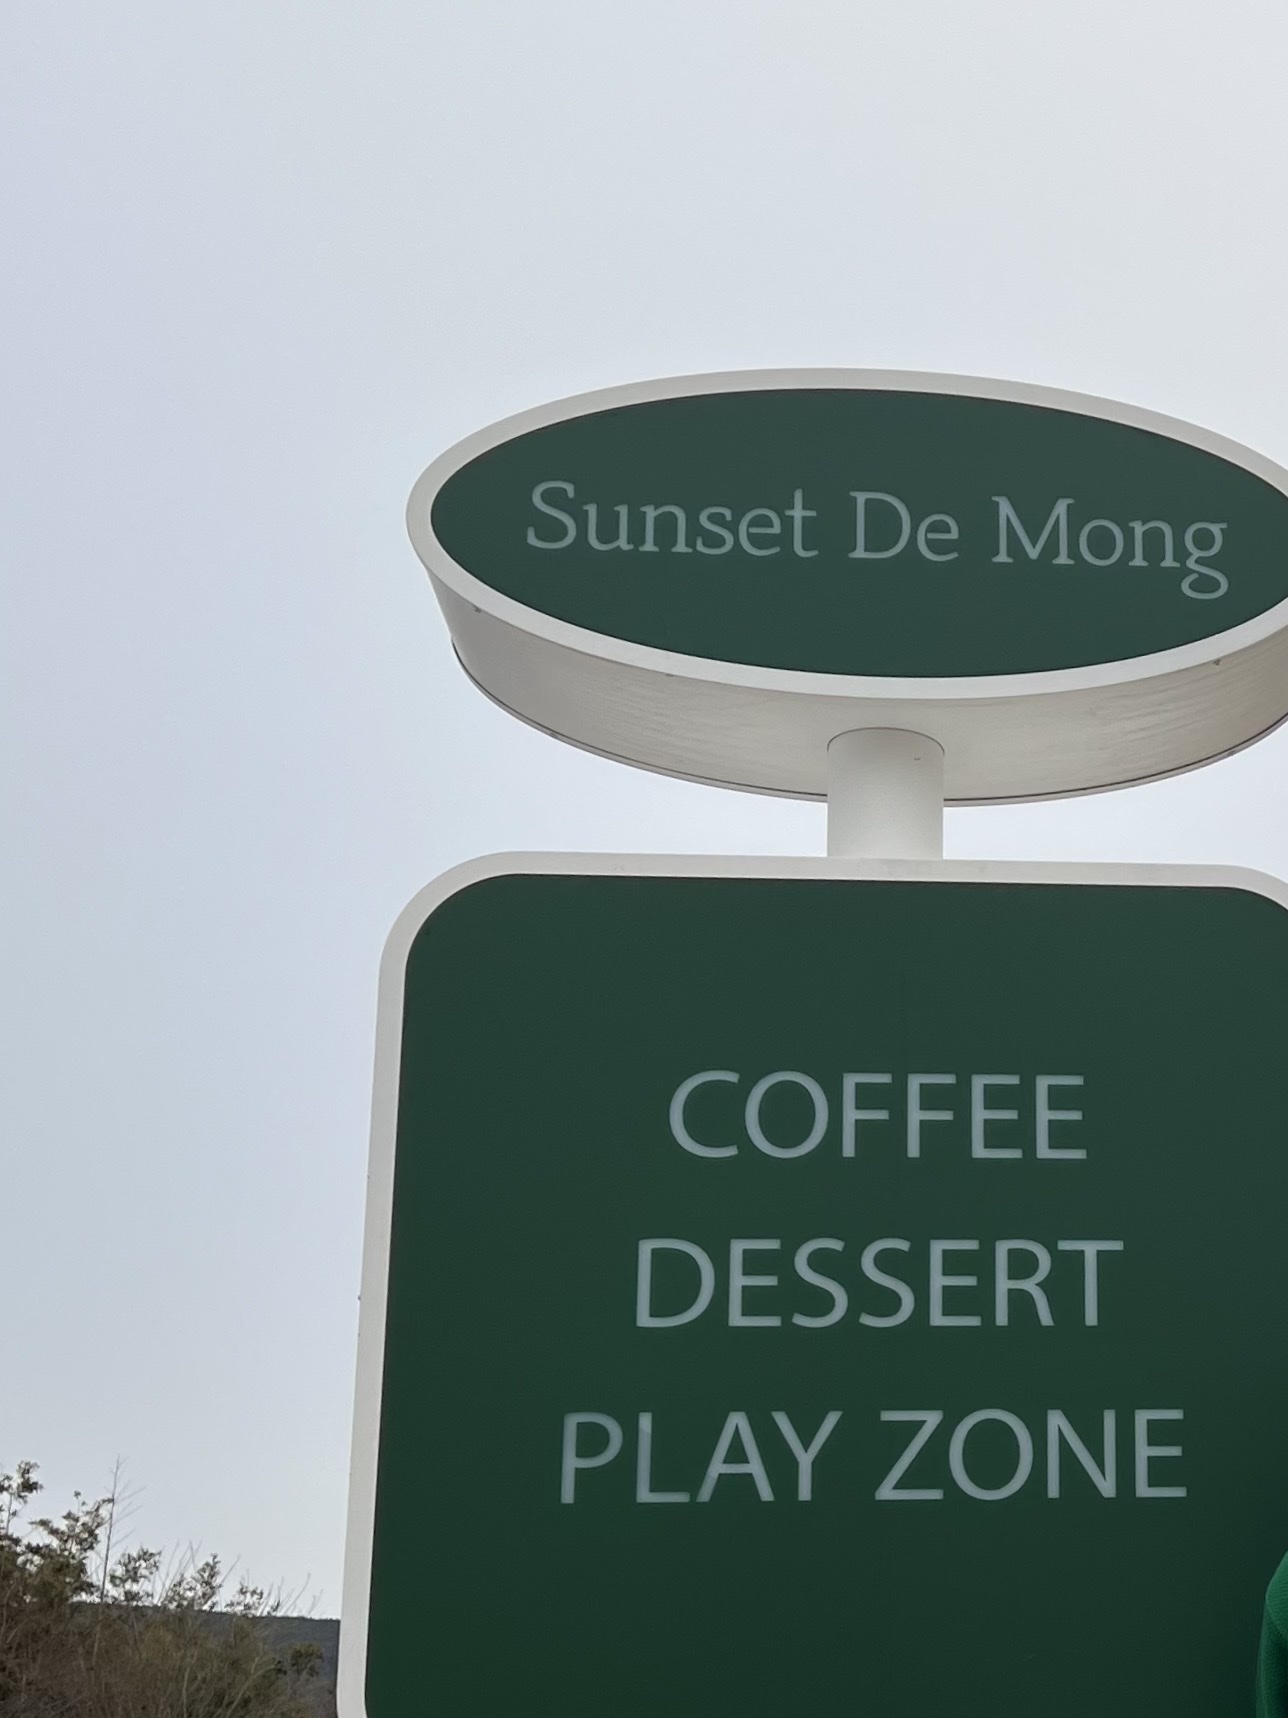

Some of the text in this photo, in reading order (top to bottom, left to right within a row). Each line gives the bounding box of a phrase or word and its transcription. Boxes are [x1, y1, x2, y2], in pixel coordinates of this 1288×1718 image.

[527, 481, 1229, 600] Sunset De Mong
[669, 1069, 1087, 1160] COFFEE
[635, 1237, 1124, 1329] DESSERT
[560, 1408, 1188, 1504] PLAY ZONE
